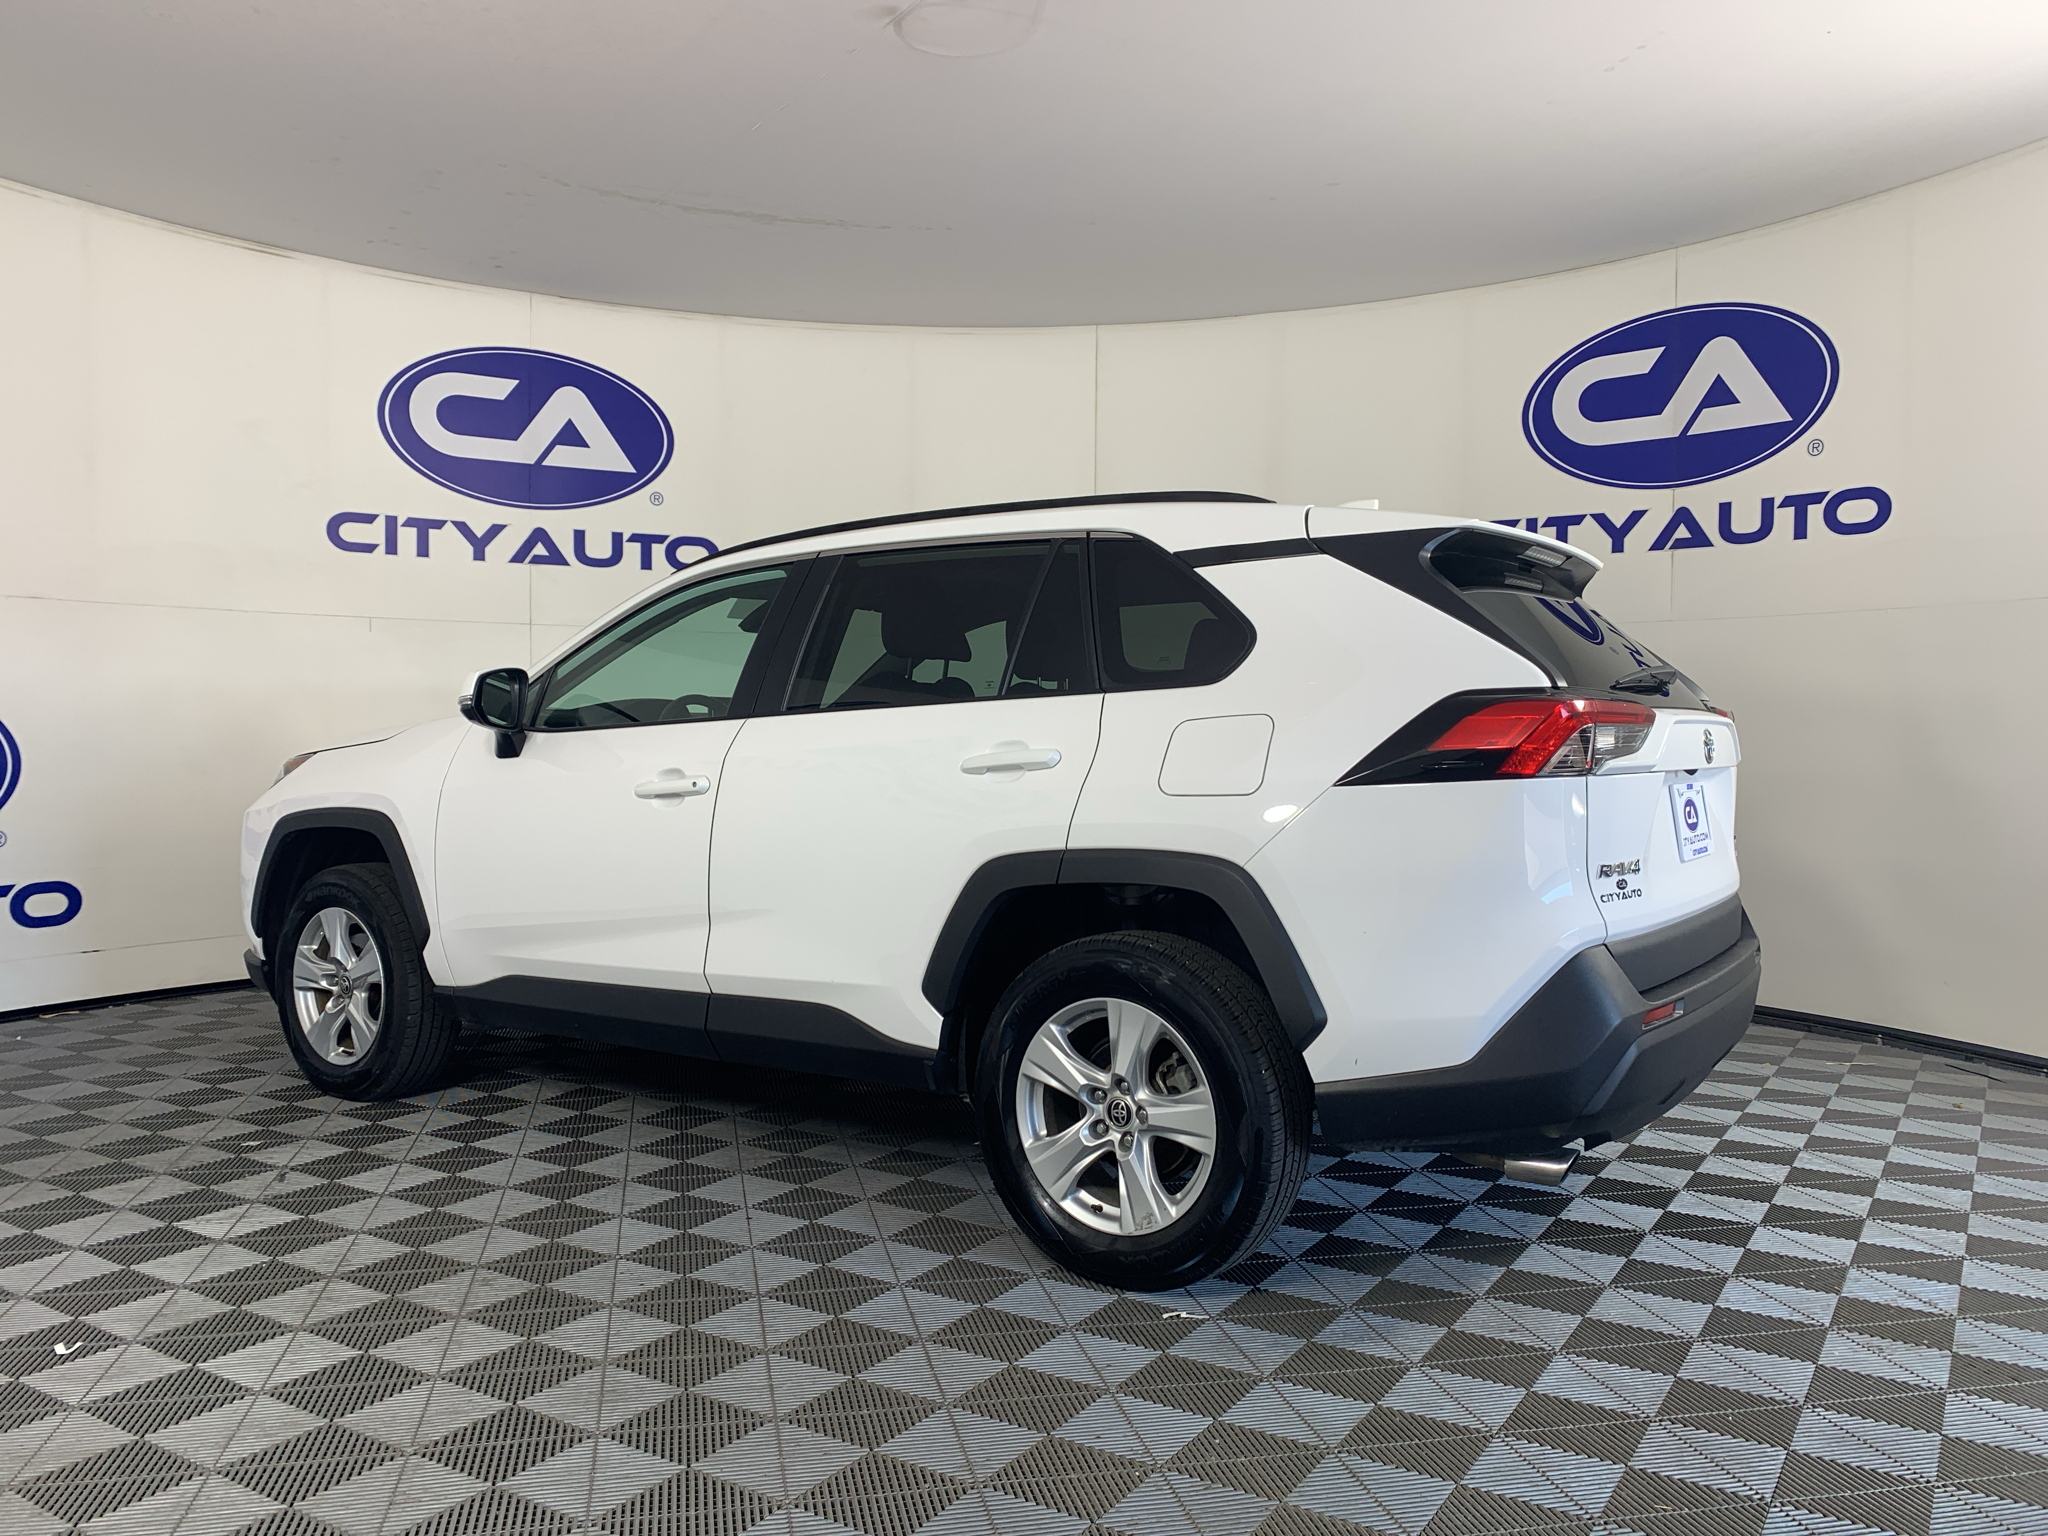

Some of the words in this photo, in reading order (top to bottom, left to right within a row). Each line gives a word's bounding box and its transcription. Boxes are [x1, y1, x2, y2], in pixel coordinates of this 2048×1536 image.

[409, 371, 638, 473] CA
[1552, 335, 1794, 446] CA
[1596, 859, 1641, 879] RAV4
